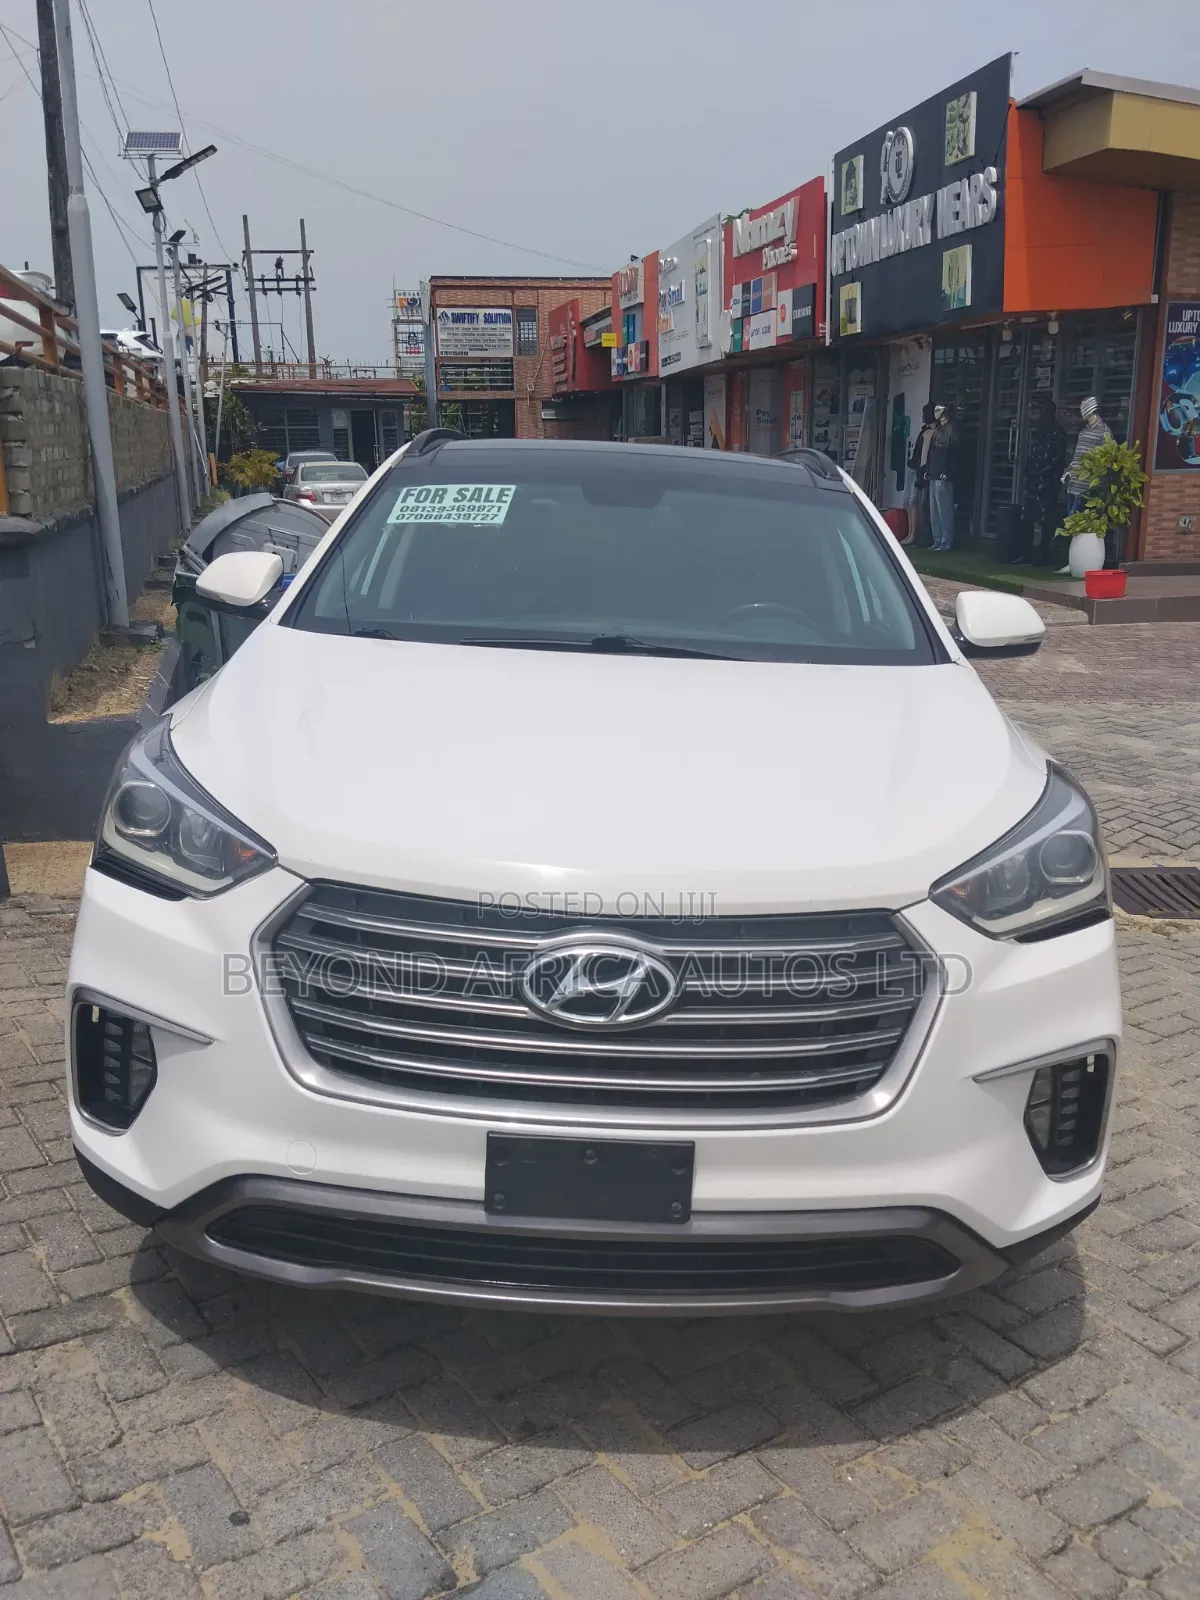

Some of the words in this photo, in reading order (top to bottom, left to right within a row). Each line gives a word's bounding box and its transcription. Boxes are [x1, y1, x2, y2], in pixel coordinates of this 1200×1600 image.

[879, 193, 935, 260] LUXURY
[936, 166, 997, 240] WEARS
[762, 242, 798, 271] Phones
[451, 312, 480, 325] SWIFTIFY
[483, 312, 512, 325] SOLUTION
[792, 305, 812, 319] SAMSUNG
[1168, 321, 1198, 334] LUXURY
[756, 408, 771, 417] Pay
[756, 416, 777, 425] Small
[400, 487, 449, 504] FOR
[452, 487, 512, 504] SALE
[399, 504, 502, 514] 08139369871
